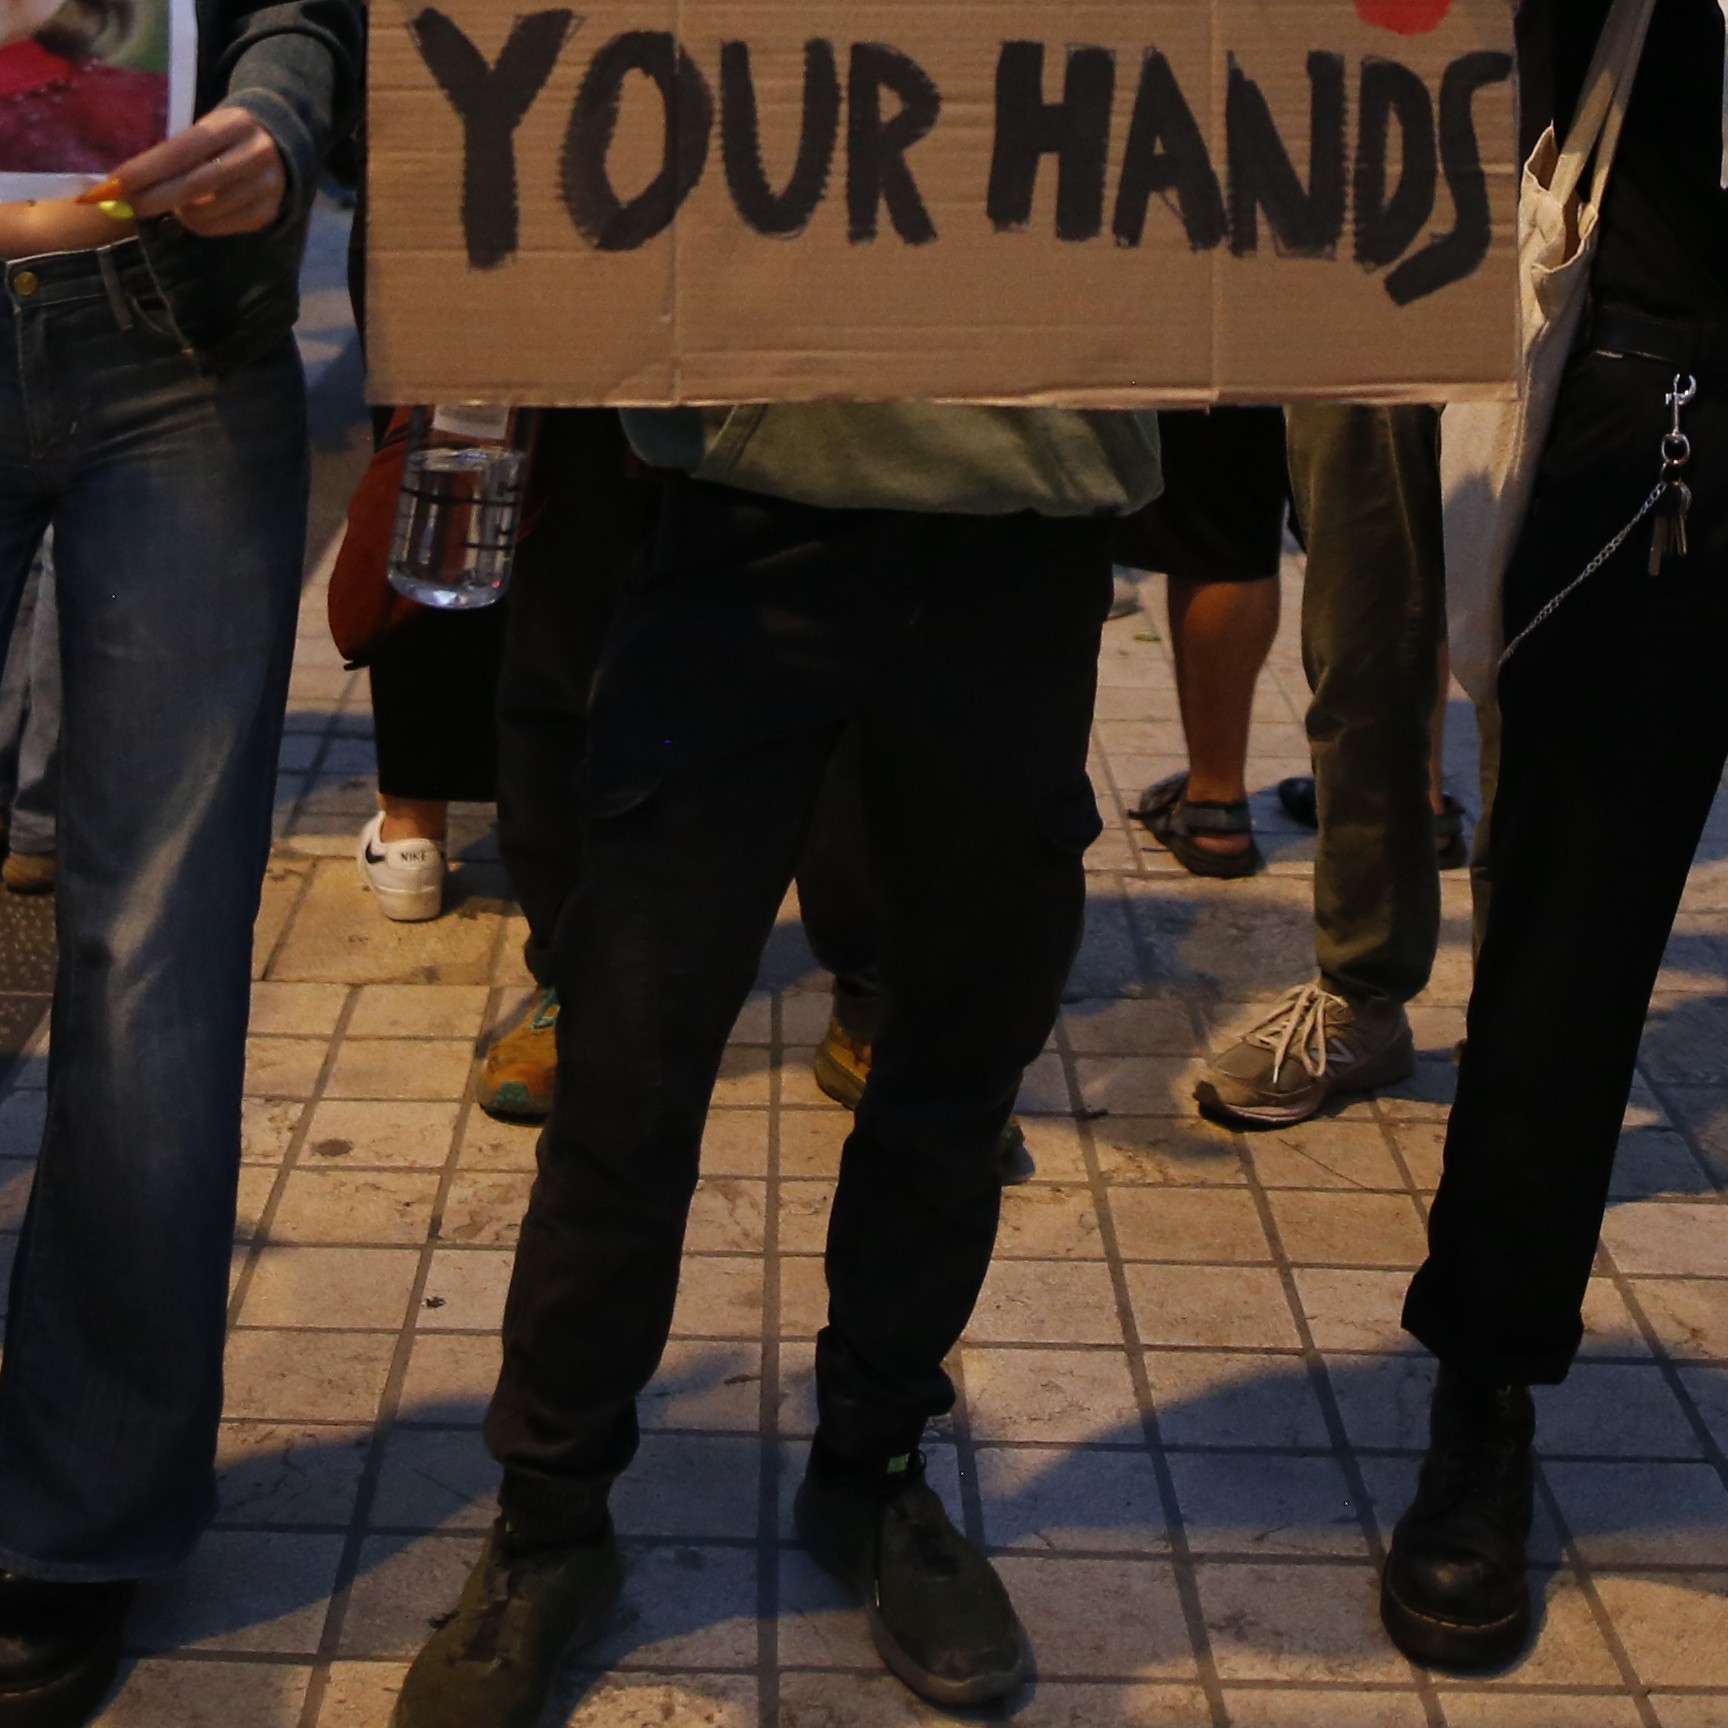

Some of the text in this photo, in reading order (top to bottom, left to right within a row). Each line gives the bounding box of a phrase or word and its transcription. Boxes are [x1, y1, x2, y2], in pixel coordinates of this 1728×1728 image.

[405, 6, 1516, 308] YOUR HANDS
[401, 851, 427, 863] NIKE
